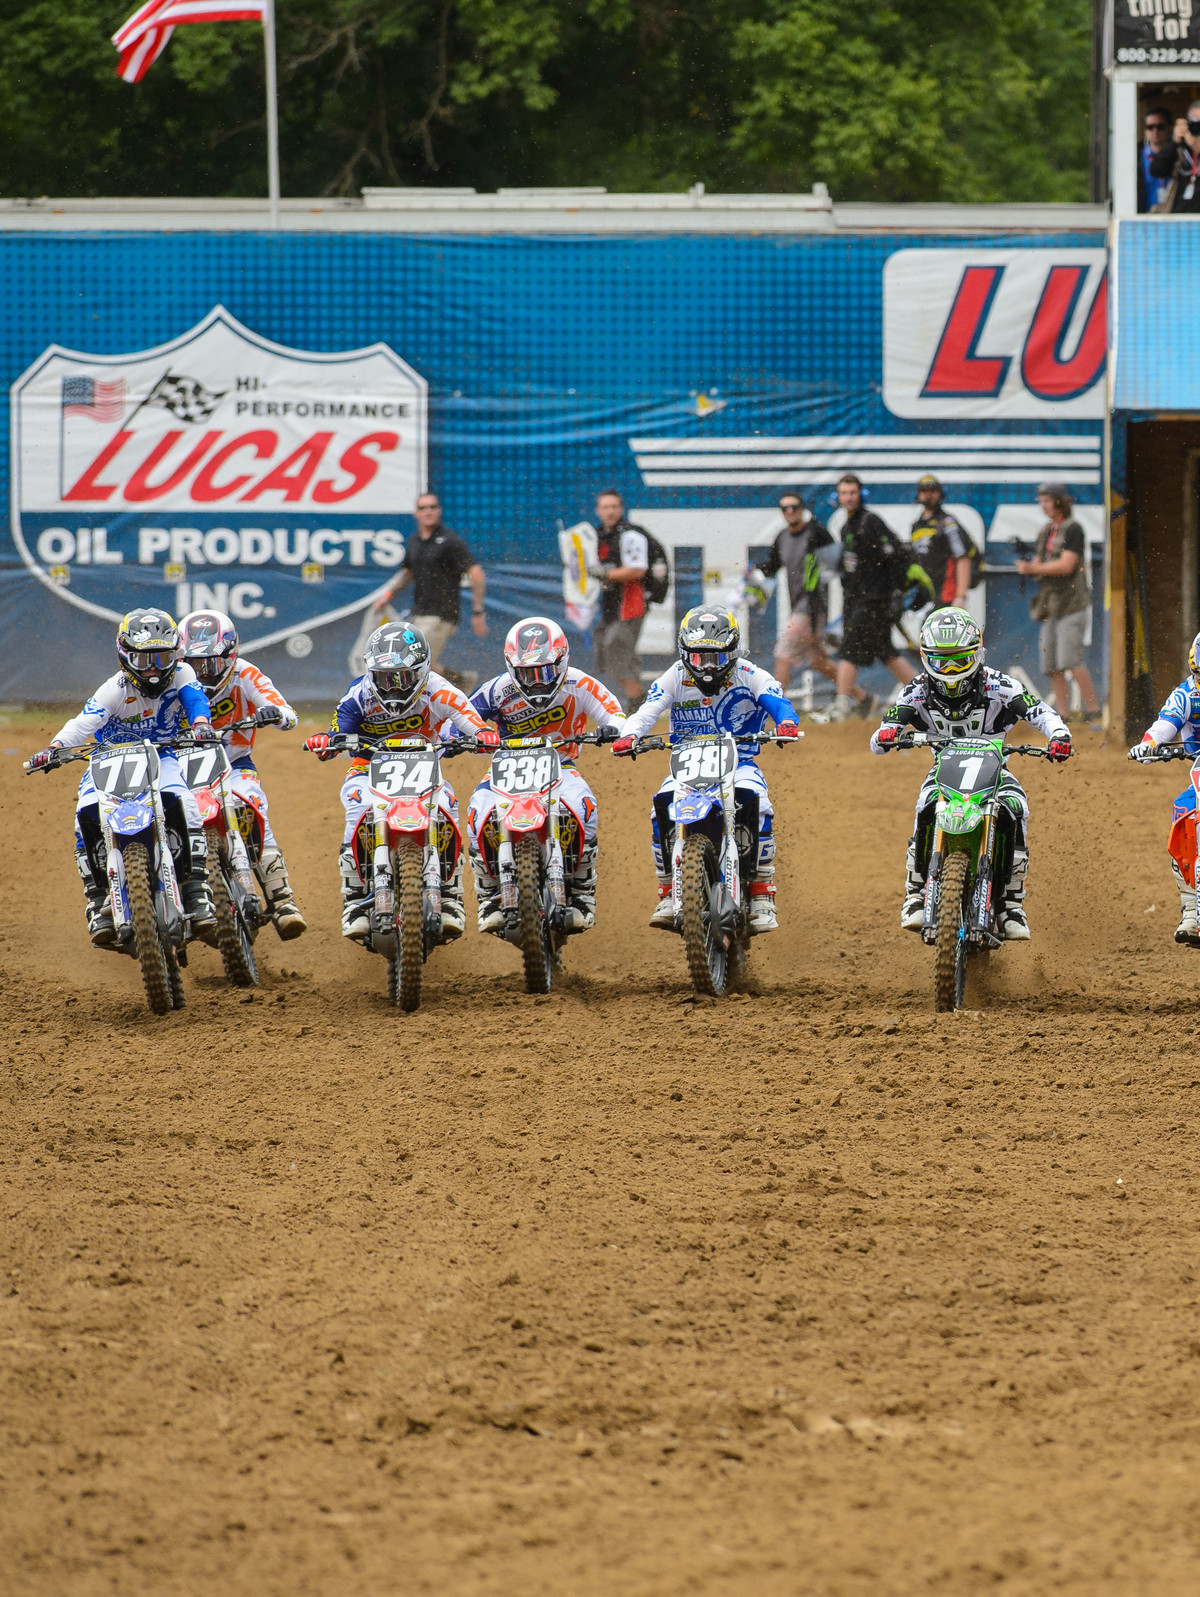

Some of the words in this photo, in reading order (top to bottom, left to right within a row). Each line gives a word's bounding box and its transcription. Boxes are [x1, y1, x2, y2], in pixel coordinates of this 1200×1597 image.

[1153, 16, 1190, 41] for
[234, 401, 412, 419] PERFORMANCE
[60, 429, 402, 504] LUCAS
[36, 527, 124, 566] OIL
[138, 528, 407, 568] PRODUCTS
[176, 581, 278, 620] INC.
[360, 715, 423, 736] GEICO
[506, 706, 567, 734] GEICO
[674, 707, 716, 722] YAMAHA
[99, 751, 149, 794] 77
[375, 760, 435, 796] 34
[496, 755, 551, 793] 338
[676, 744, 730, 783] 38
[958, 756, 985, 790] 1
